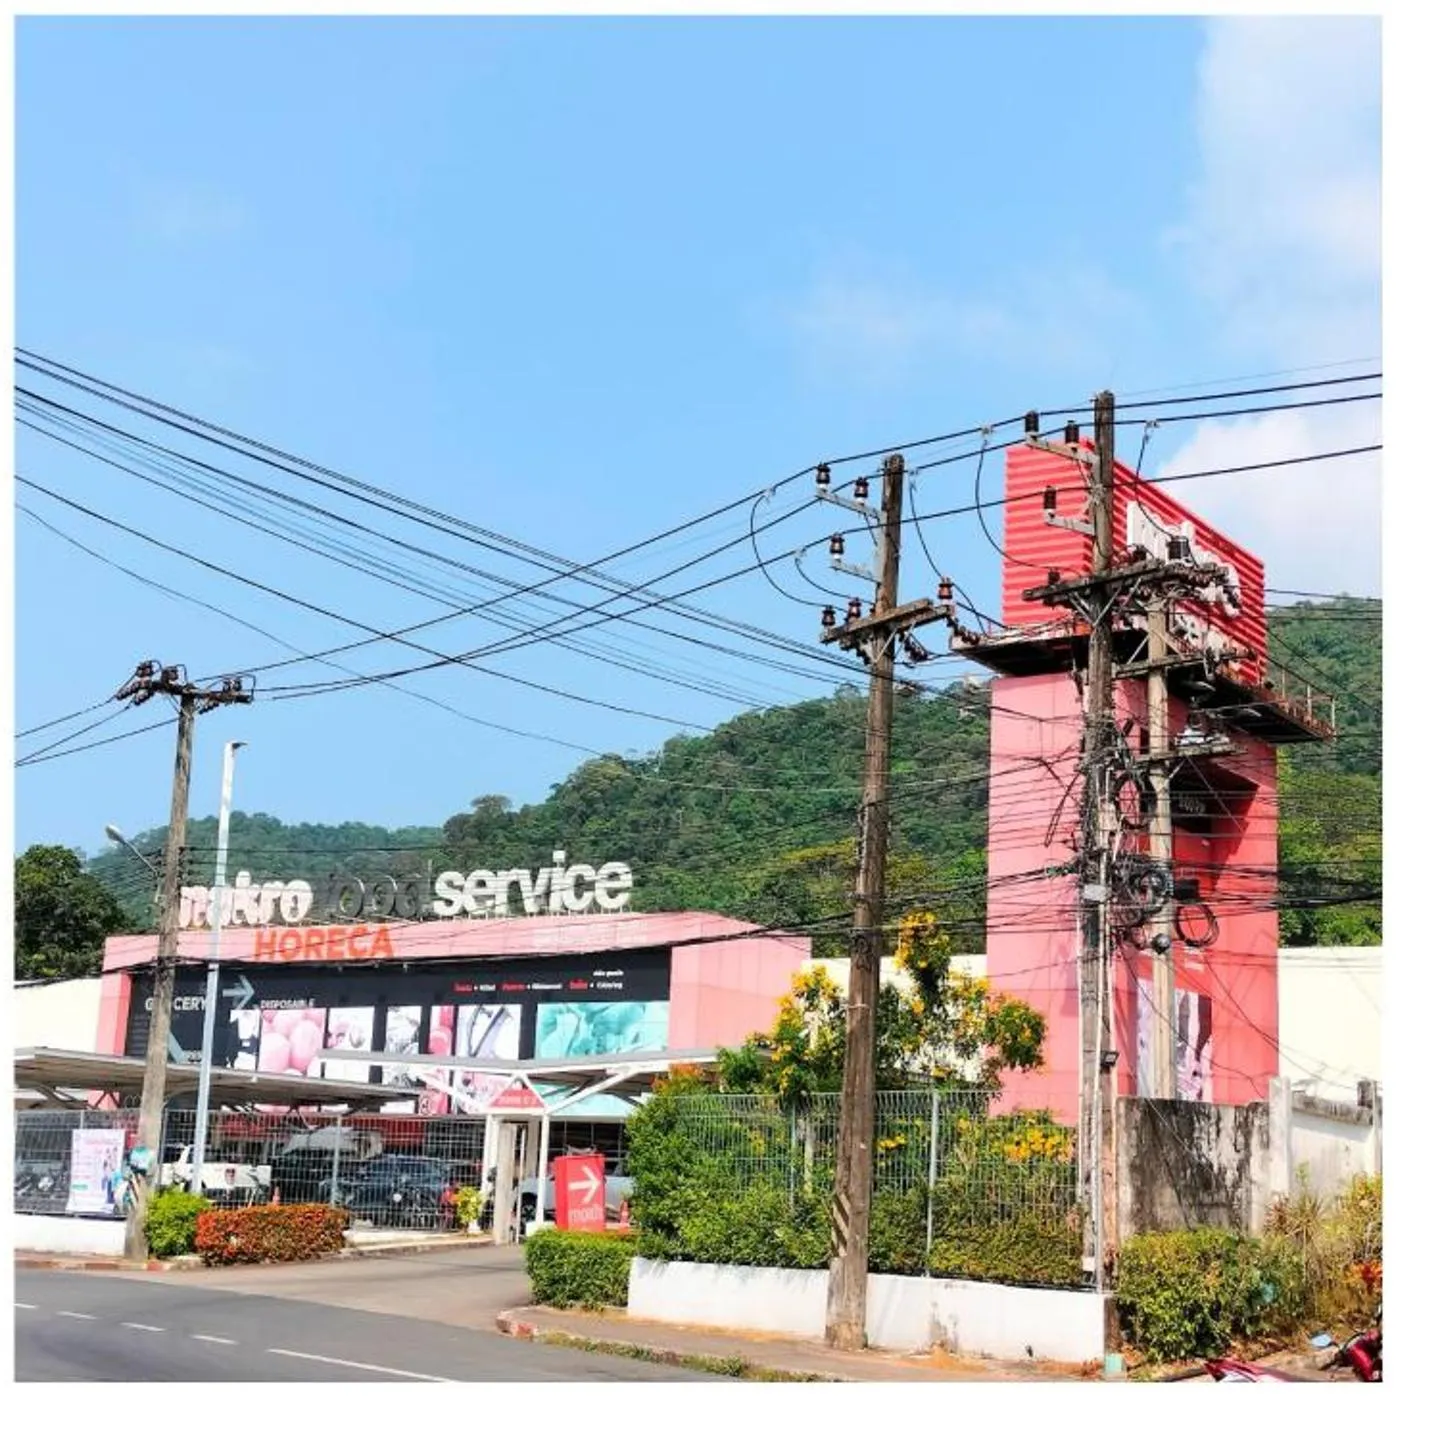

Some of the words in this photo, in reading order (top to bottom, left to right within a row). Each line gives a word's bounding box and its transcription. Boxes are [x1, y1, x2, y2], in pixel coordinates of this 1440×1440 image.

[433, 850, 633, 917] service
[254, 925, 396, 961] HORECA
[144, 995, 207, 1012] GCERY
